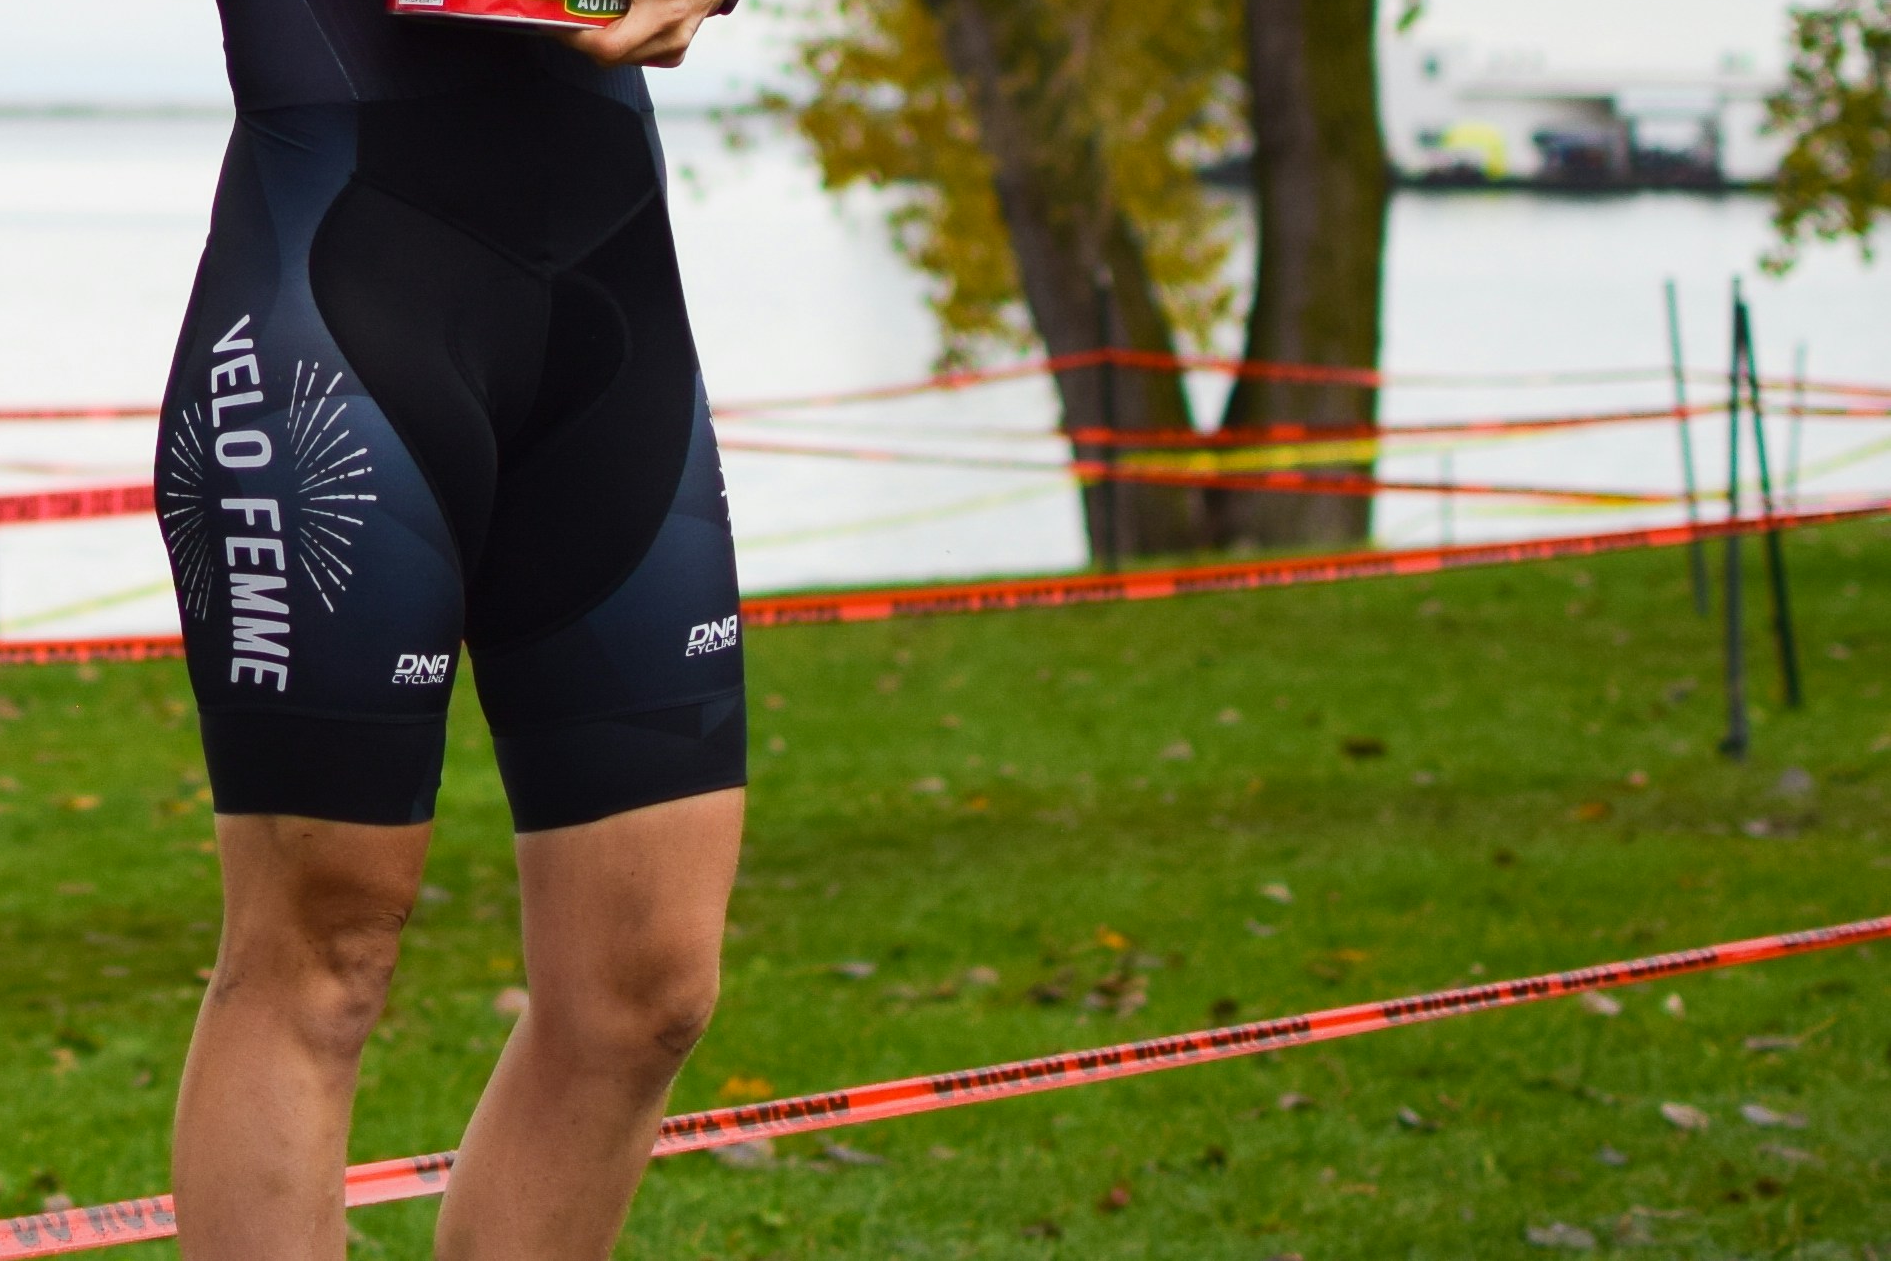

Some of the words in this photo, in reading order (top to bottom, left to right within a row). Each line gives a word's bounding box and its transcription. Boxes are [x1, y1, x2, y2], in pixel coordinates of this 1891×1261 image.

[211, 314, 272, 469] VELO
[220, 498, 290, 692] FEMME
[688, 614, 738, 648] DNA
[685, 635, 737, 657] CYCLING
[395, 654, 450, 674] DNA
[392, 674, 445, 685] CYCLING
